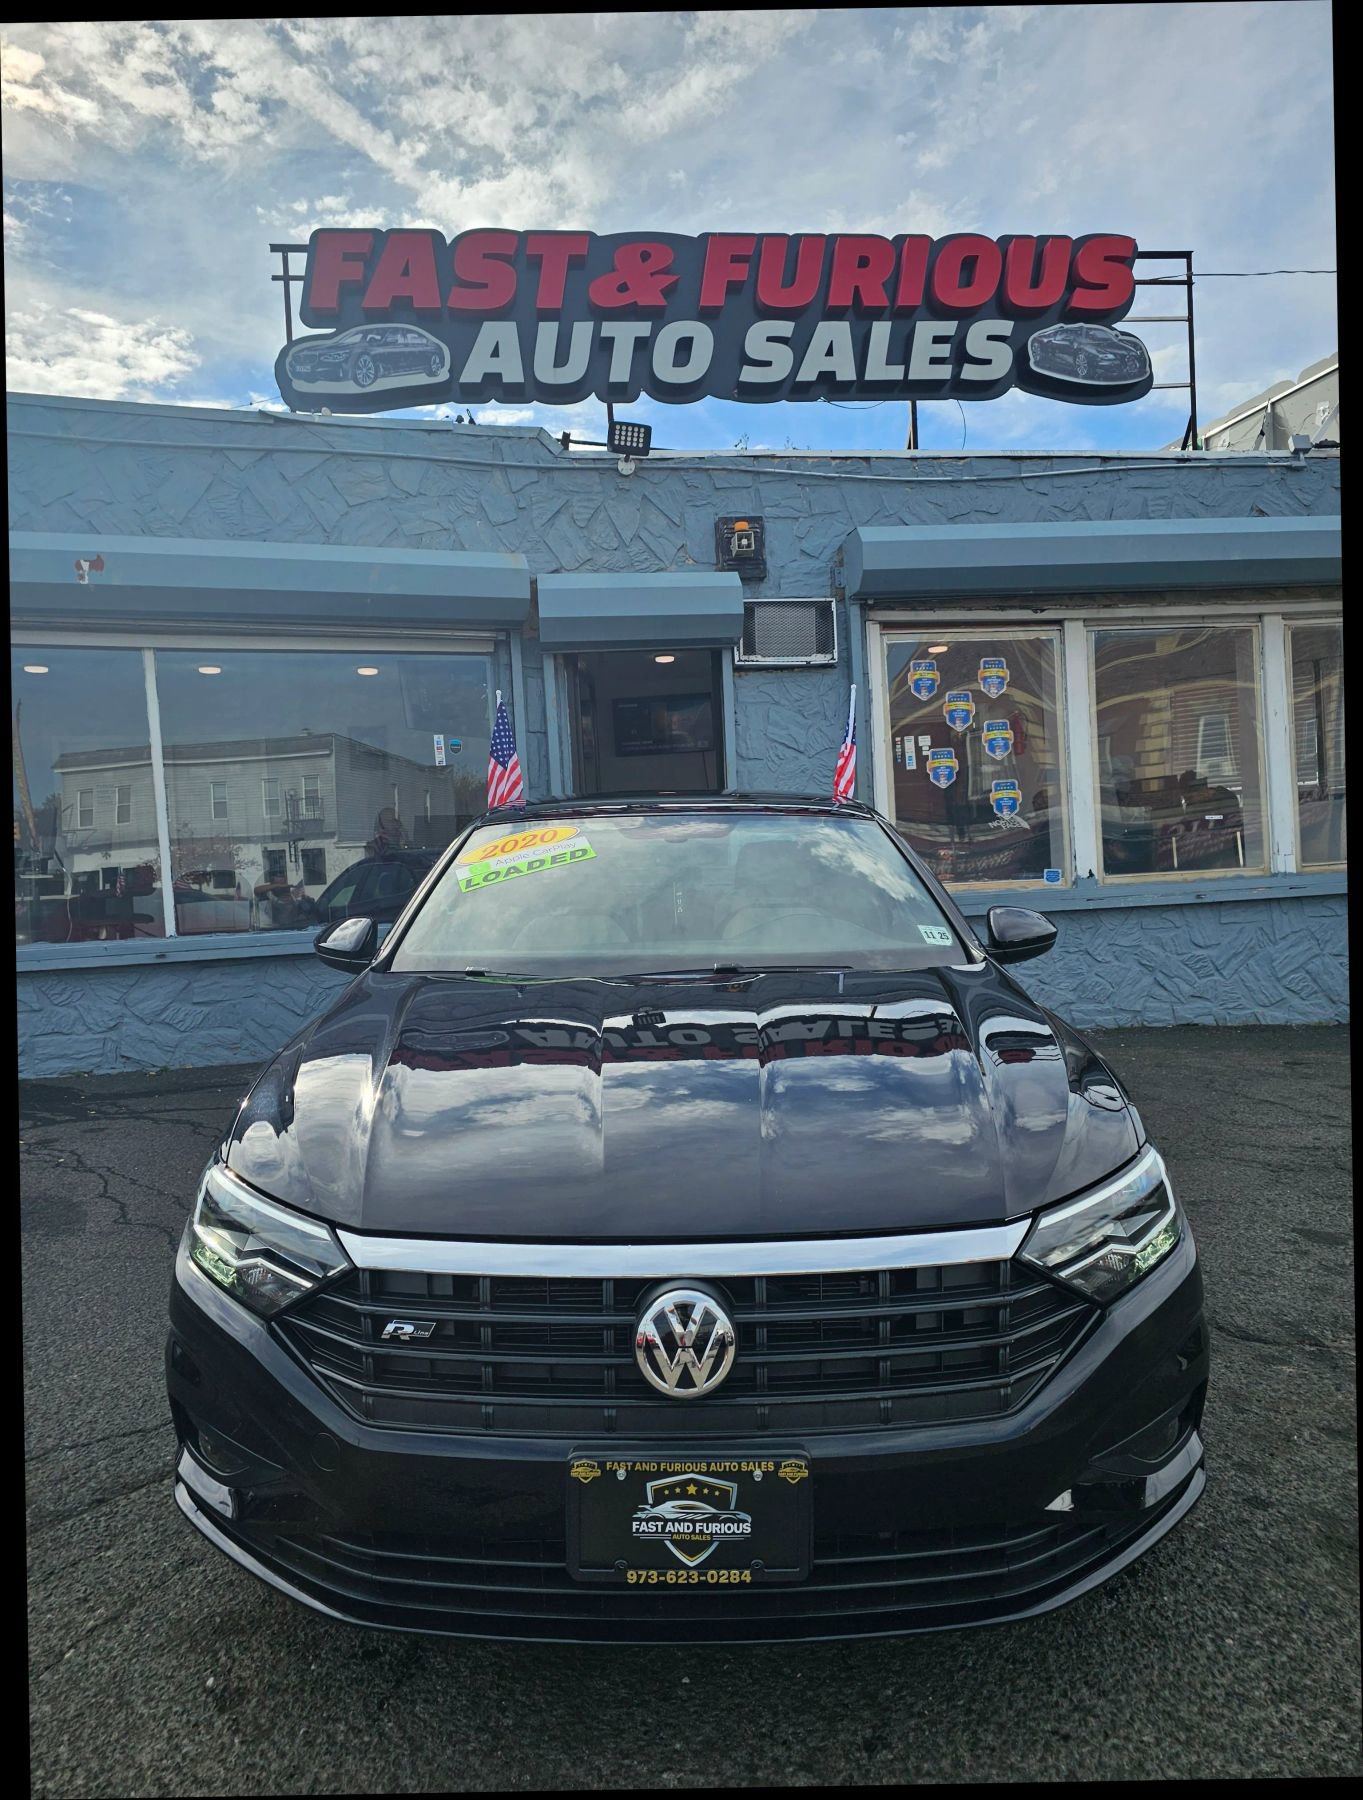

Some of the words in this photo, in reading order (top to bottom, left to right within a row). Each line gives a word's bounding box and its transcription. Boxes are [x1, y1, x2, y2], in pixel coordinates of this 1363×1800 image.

[308, 232, 589, 313] FAST
[589, 242, 681, 310] &
[698, 234, 1137, 312] FURIOUS
[459, 320, 715, 385] AUTO
[739, 319, 1015, 384] SALES
[480, 829, 558, 861] 2020
[495, 852, 530, 867] Apple
[464, 848, 589, 890] LOADED
[381, 1323, 415, 1340] R
[606, 1461, 633, 1472] FAST
[635, 1461, 658, 1472] AND
[660, 1461, 707, 1472] FURIOUS
[709, 1461, 739, 1472] AUTO
[741, 1461, 775, 1472] SALES
[632, 1521, 664, 1533] FAST
[665, 1521, 693, 1533] AND
[695, 1522, 752, 1534] FURIOUS
[626, 1570, 752, 1584] 973-623-0284
